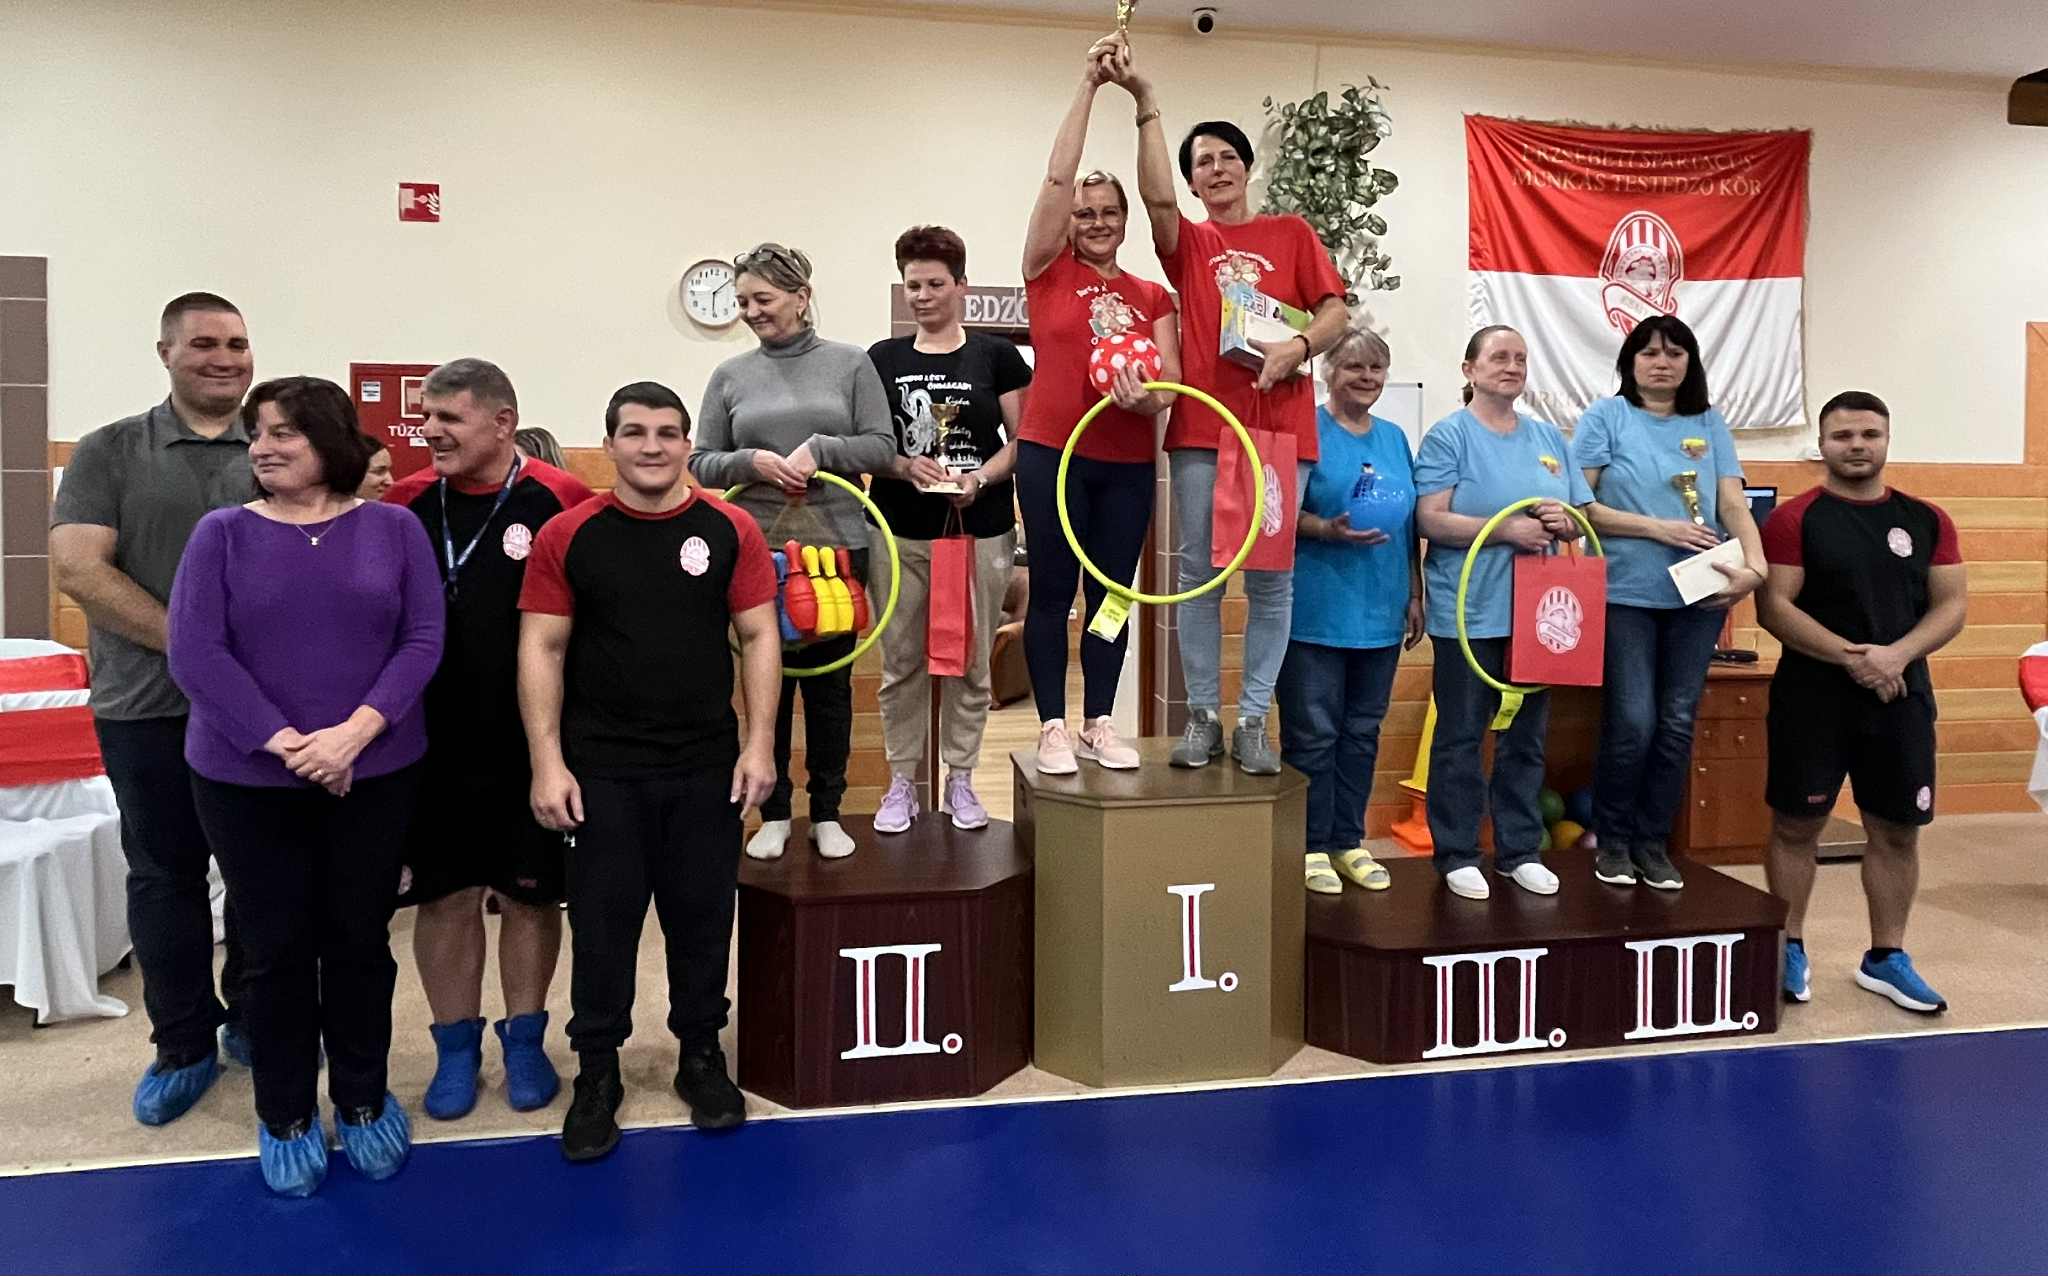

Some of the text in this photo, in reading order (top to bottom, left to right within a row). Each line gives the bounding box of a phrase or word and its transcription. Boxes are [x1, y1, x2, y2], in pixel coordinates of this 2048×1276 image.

[1719, 174, 1762, 197] KÖR
[1167, 883, 1239, 992] I.
[840, 943, 963, 1060] II.
[1422, 933, 1760, 1059] III. III.
